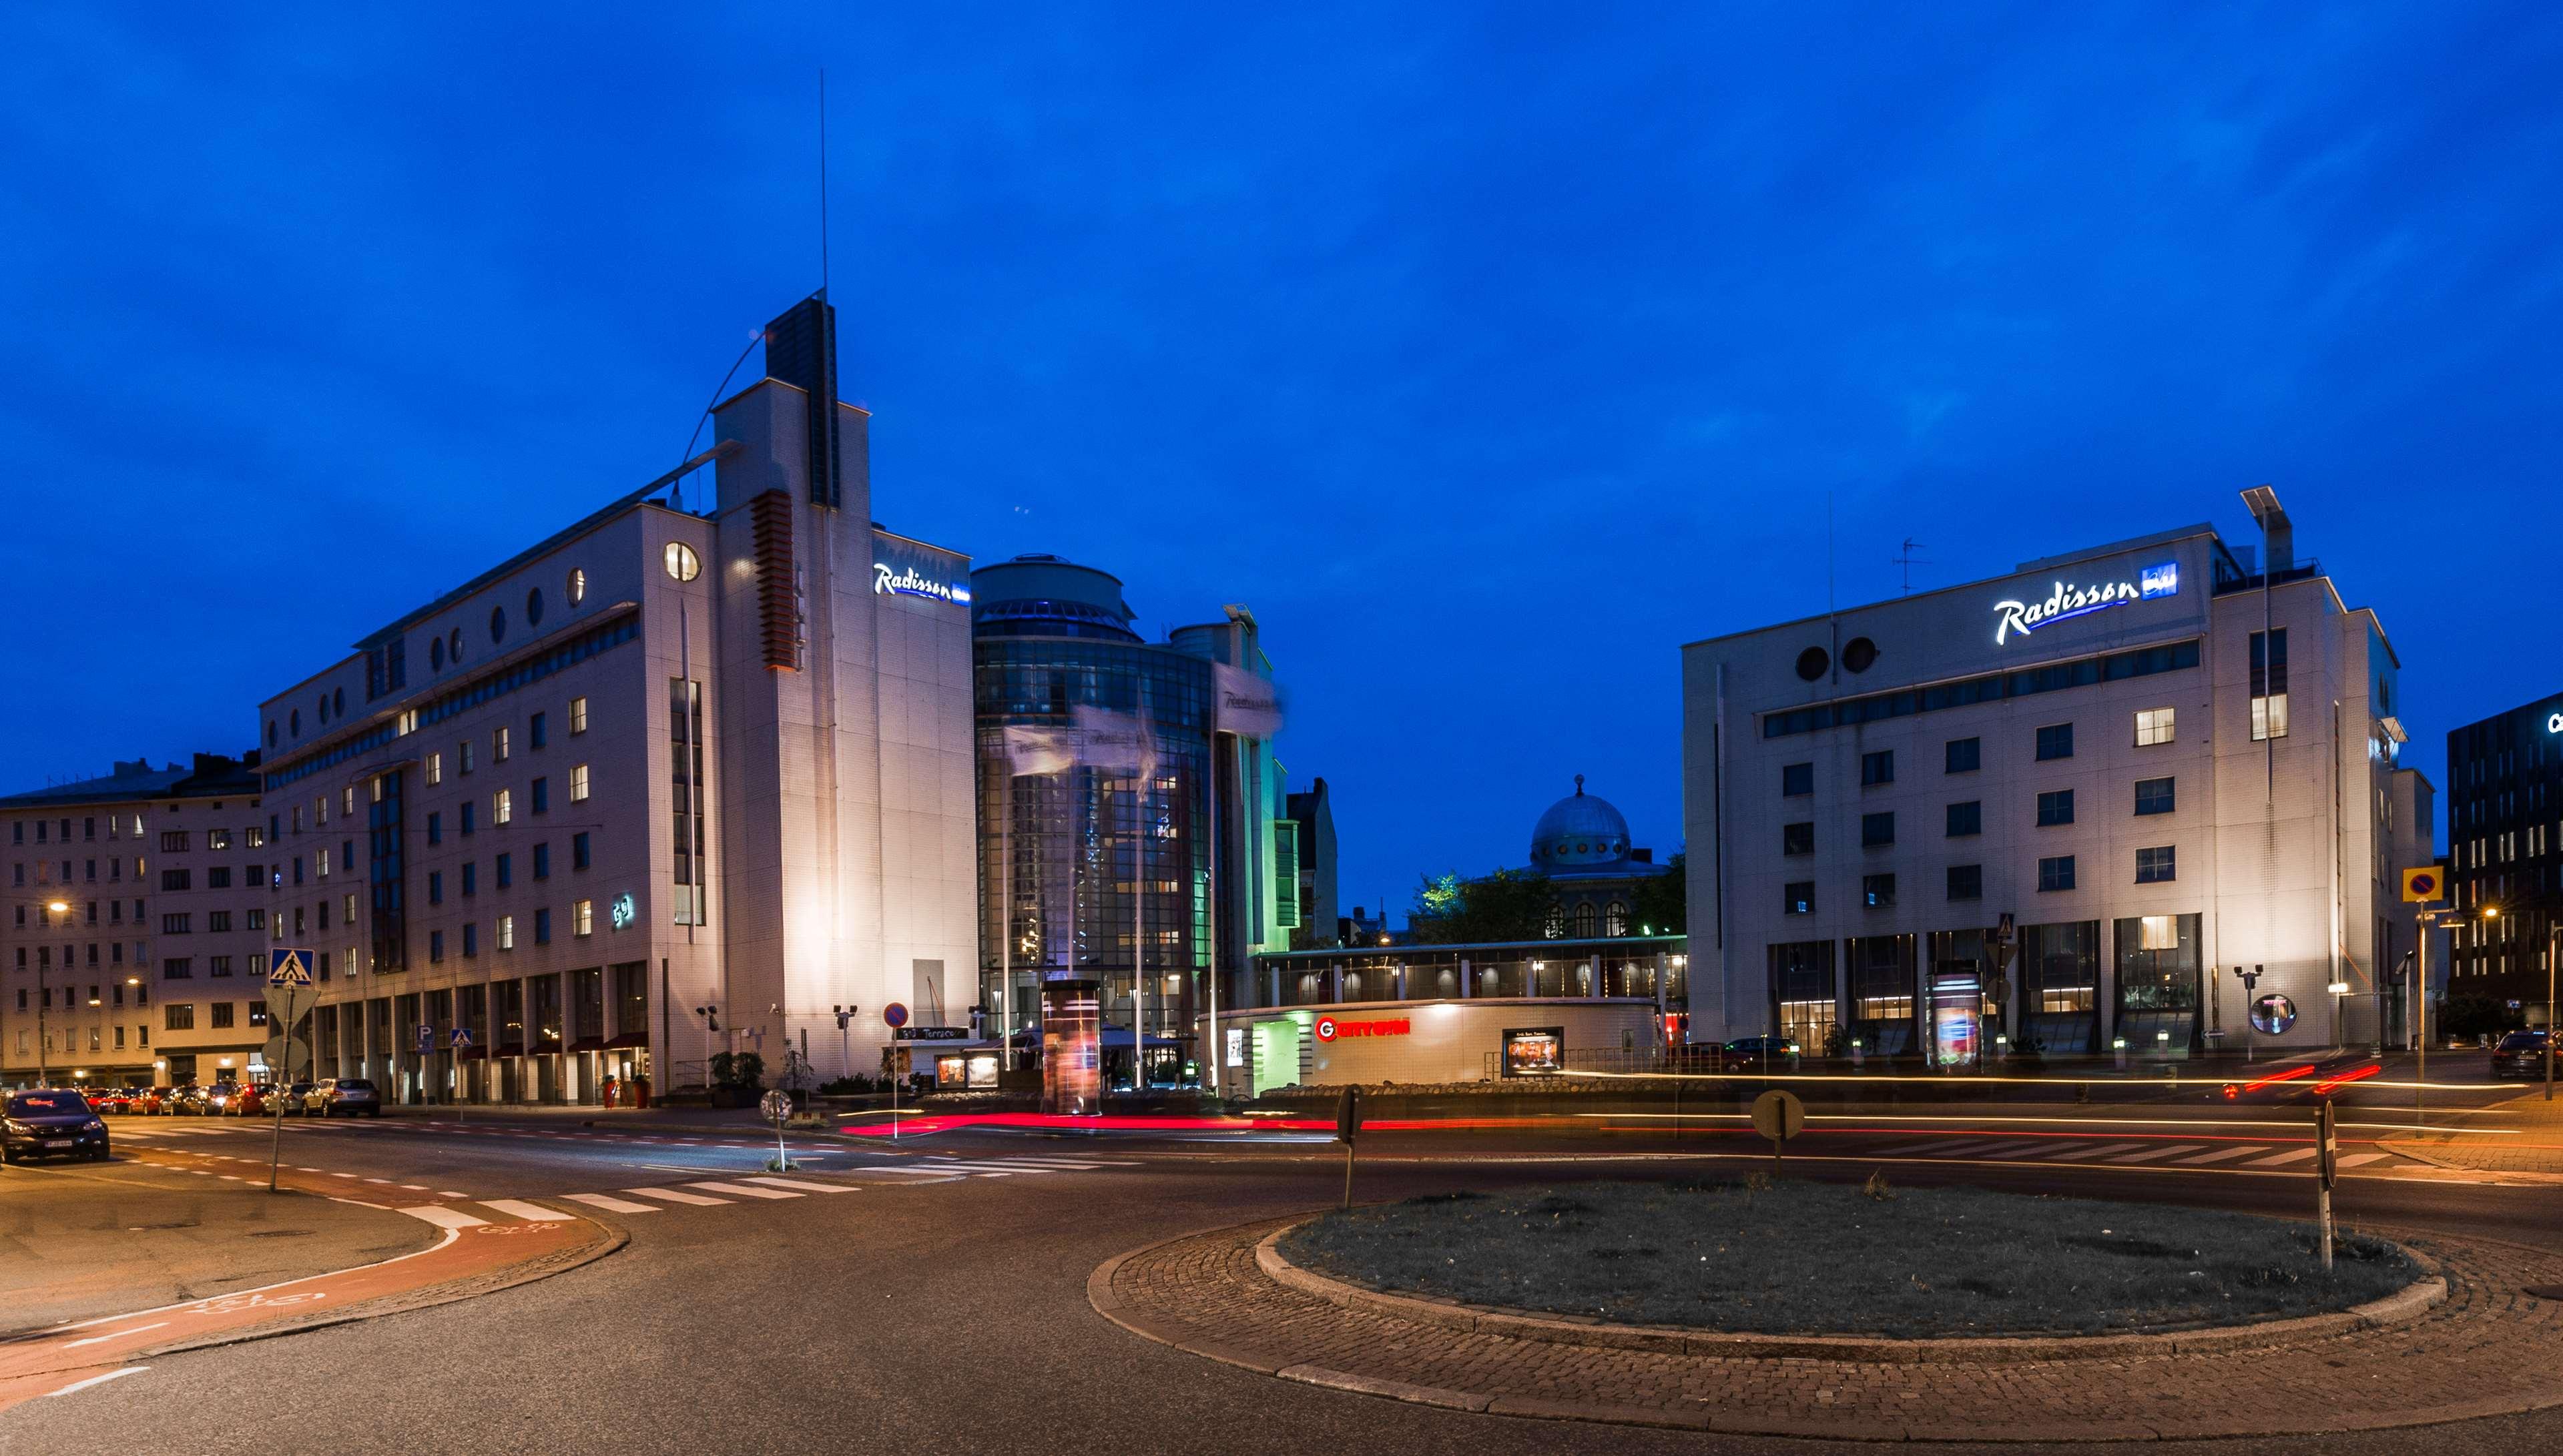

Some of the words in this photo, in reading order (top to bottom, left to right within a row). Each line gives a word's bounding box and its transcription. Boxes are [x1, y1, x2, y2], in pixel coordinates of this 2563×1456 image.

[874, 563, 951, 599] Radisson
[1993, 581, 2139, 645] Radisson
[420, 1026, 431, 1040] P
